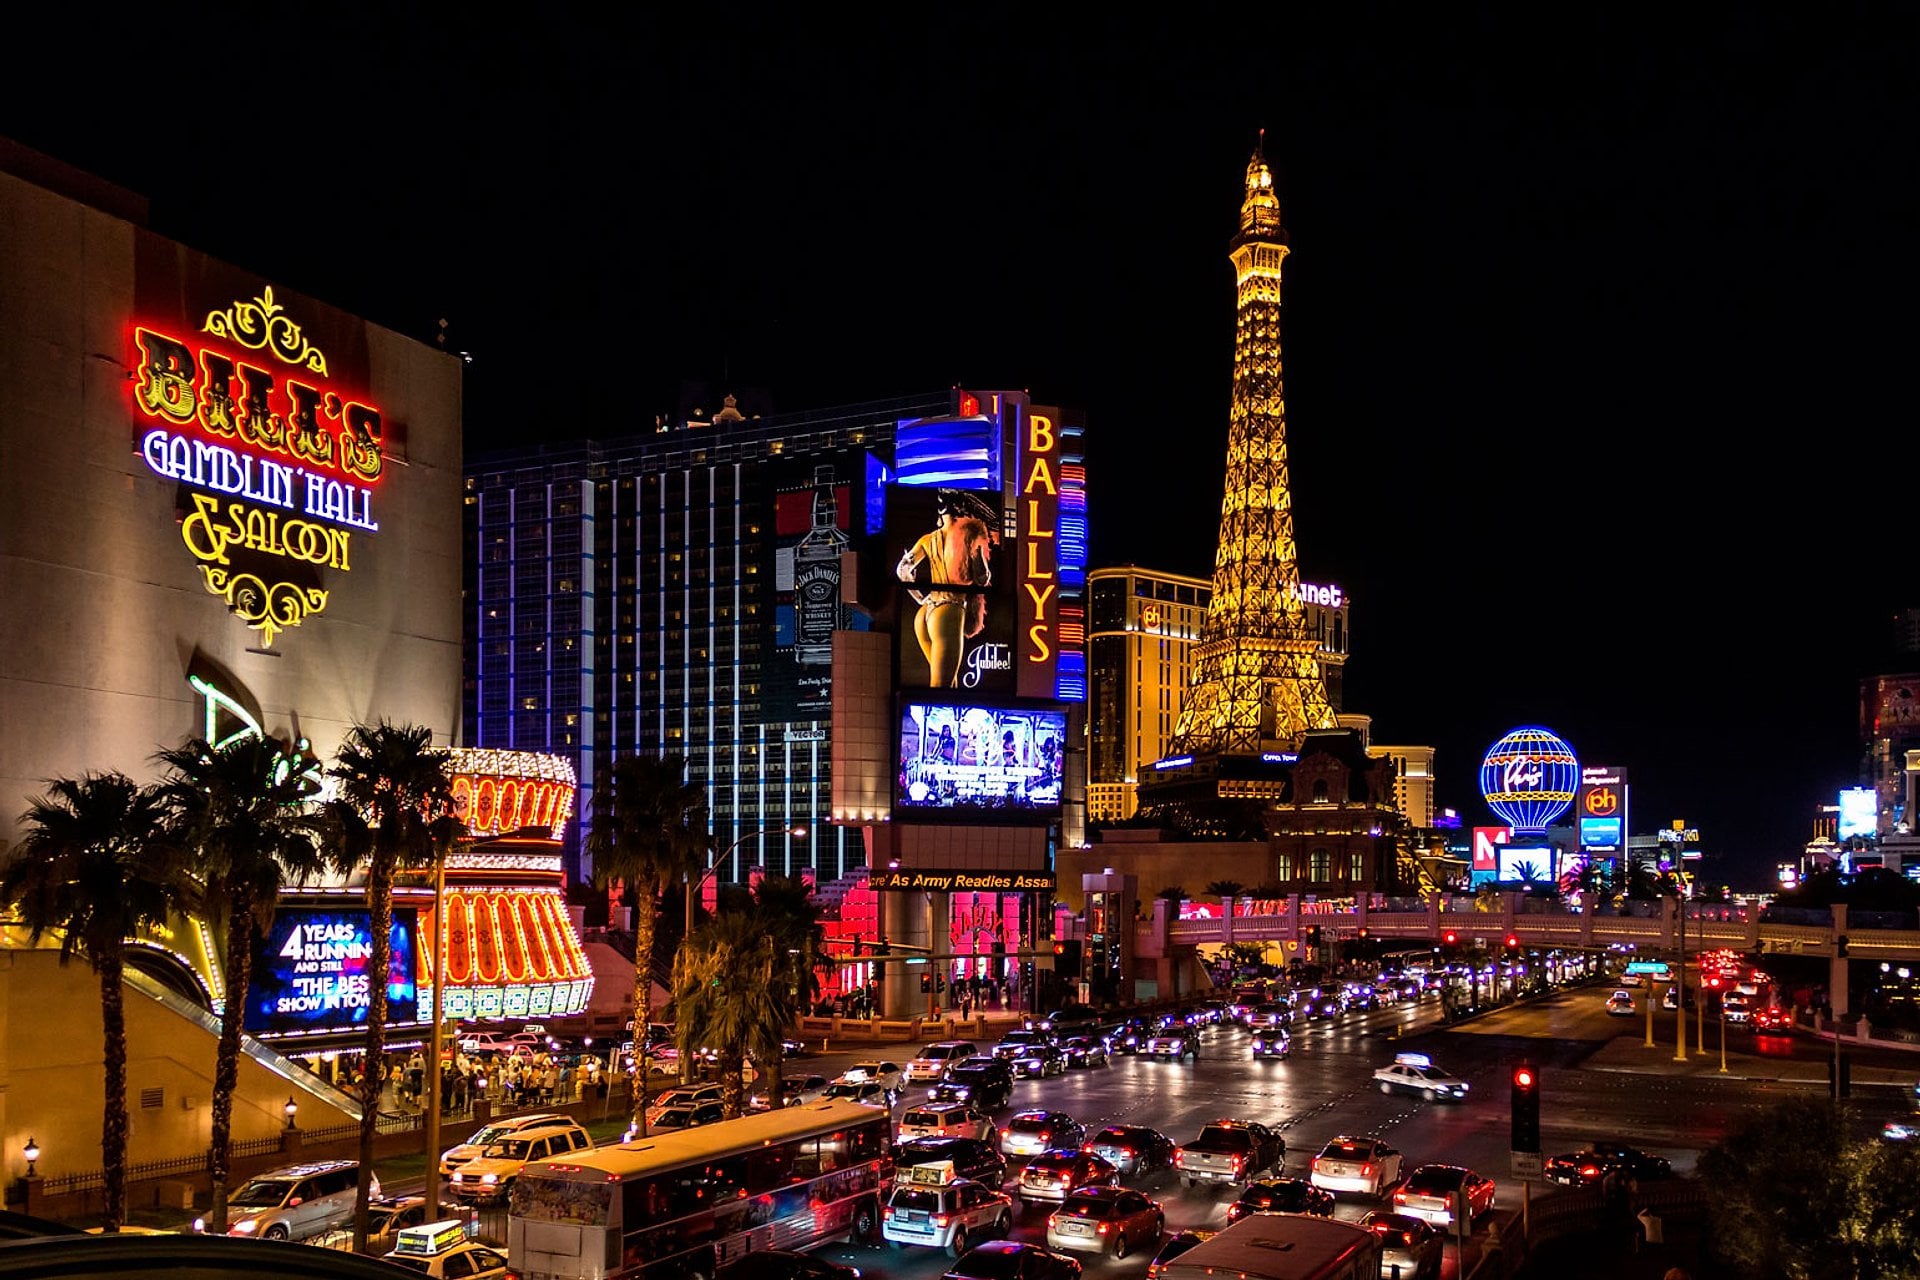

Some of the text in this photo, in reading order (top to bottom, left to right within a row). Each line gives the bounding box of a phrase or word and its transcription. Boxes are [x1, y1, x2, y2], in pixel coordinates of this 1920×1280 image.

[135, 327, 383, 482] BILL'S
[304, 474, 378, 531] HALL
[182, 492, 350, 571] & SALOON
[962, 643, 1012, 689] Jubilee!
[1503, 755, 1543, 798] Paris
[1589, 788, 1617, 813] ph
[890, 873, 910, 887] As
[913, 873, 952, 890] Army
[955, 874, 1011, 888] Readies
[279, 923, 355, 961] 4 YEARS
[304, 942, 373, 961] RUNNIN
[293, 960, 344, 973] AND STILL
[338, 974, 370, 994] BES
[277, 993, 370, 1013] SHOW IN TOW
